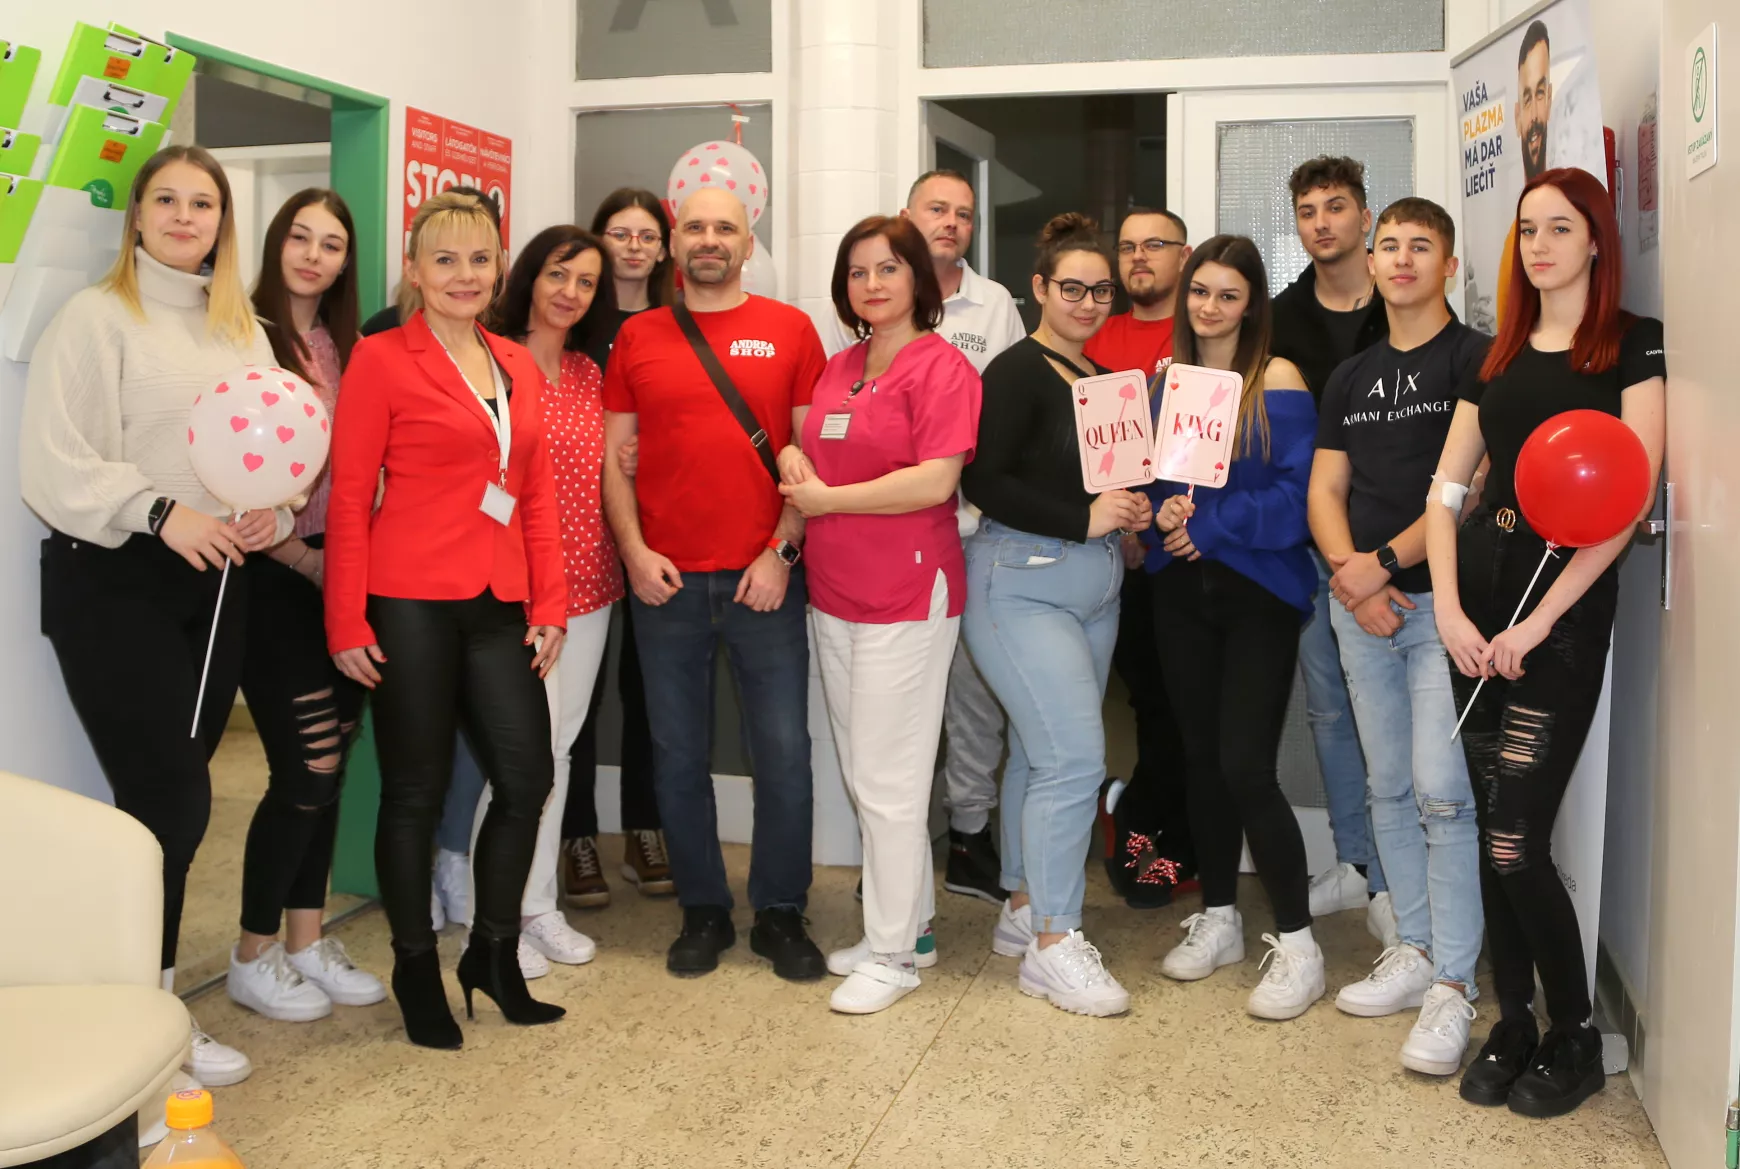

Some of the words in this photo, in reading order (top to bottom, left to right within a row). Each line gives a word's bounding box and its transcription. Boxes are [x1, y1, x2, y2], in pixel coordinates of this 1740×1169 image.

[1463, 80, 1488, 112] VAŠA
[1463, 103, 1504, 141] PLAZMA
[1464, 140, 1479, 169] MÁ
[1481, 134, 1503, 162] DAR
[1465, 162, 1496, 198] LIEČIŤ
[729, 339, 776, 351] ANDREA
[951, 332, 987, 347] ANDREA
[951, 341, 987, 353] SHOP
[729, 348, 776, 358] SHOP
[1078, 384, 1085, 396] Q
[1387, 400, 1452, 422] EXCHANGE
[1086, 418, 1145, 450] QUEEN
[1172, 412, 1222, 442] KING
